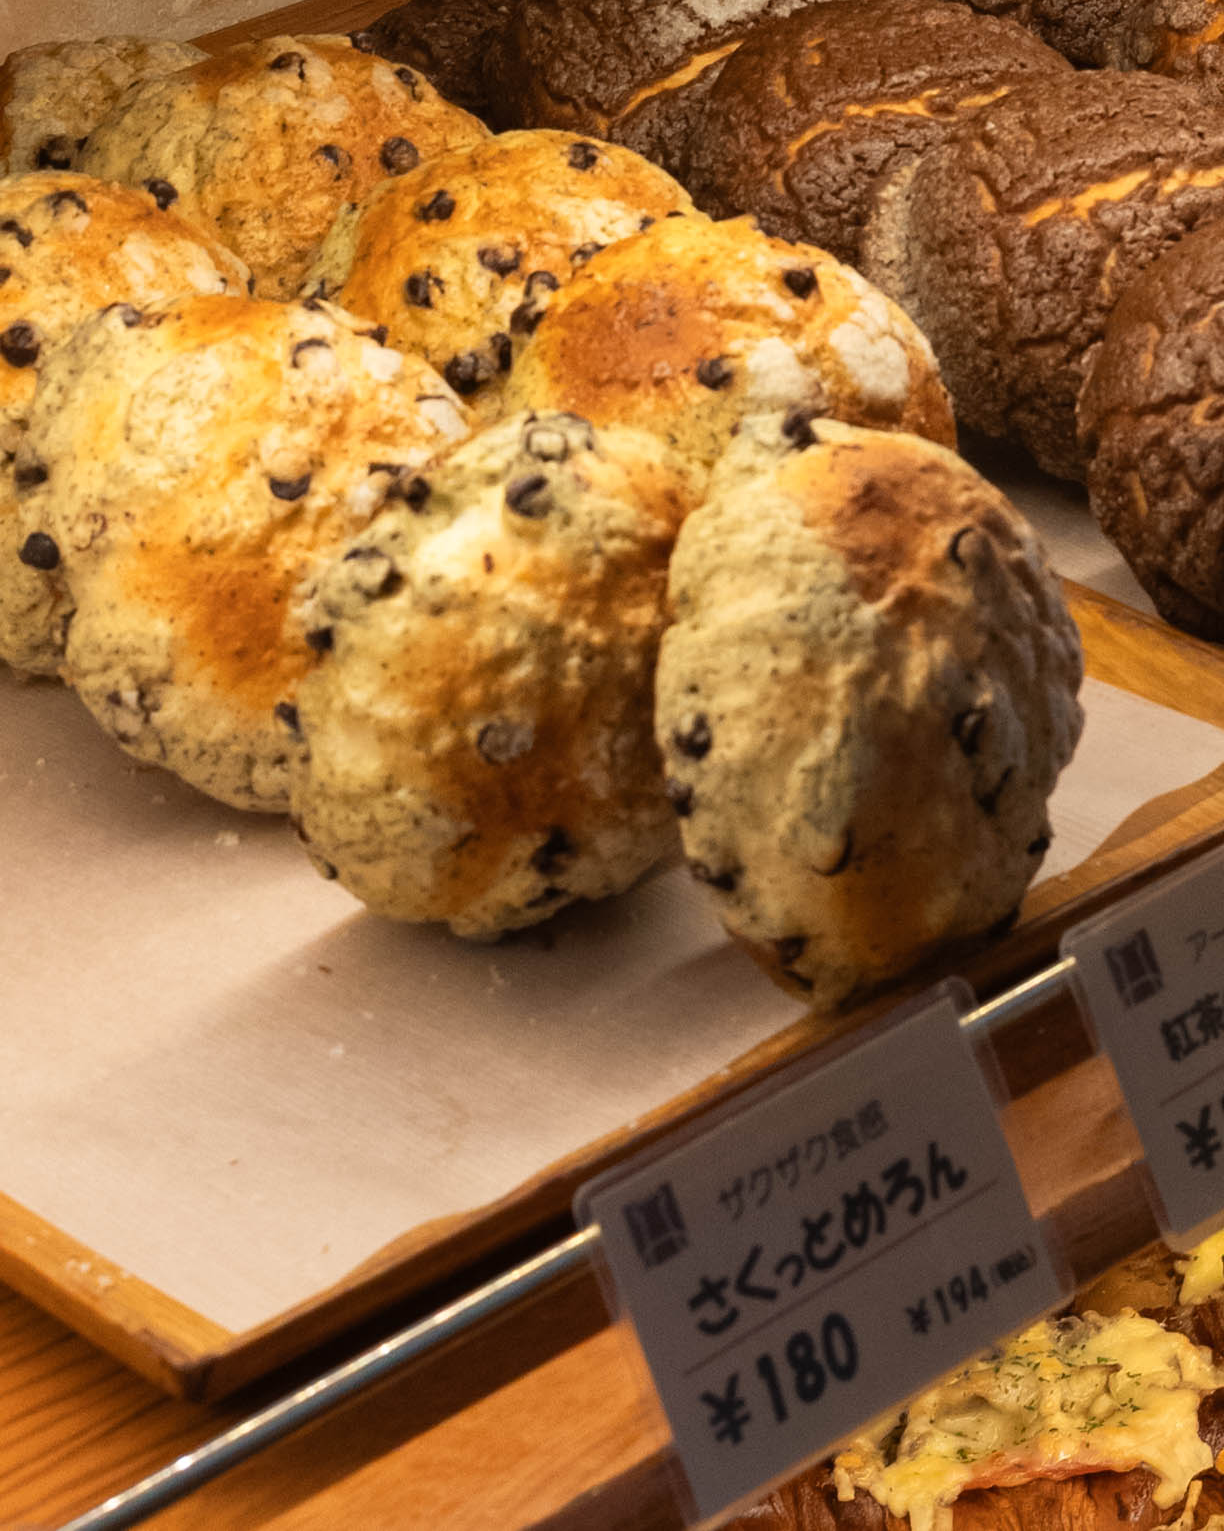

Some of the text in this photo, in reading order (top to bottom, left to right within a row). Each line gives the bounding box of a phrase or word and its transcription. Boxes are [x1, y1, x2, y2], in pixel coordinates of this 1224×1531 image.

[687, 1142, 969, 1337] さくっとめろん
[700, 1312, 860, 1446] ¥180
[905, 1266, 988, 1336] ¥194
